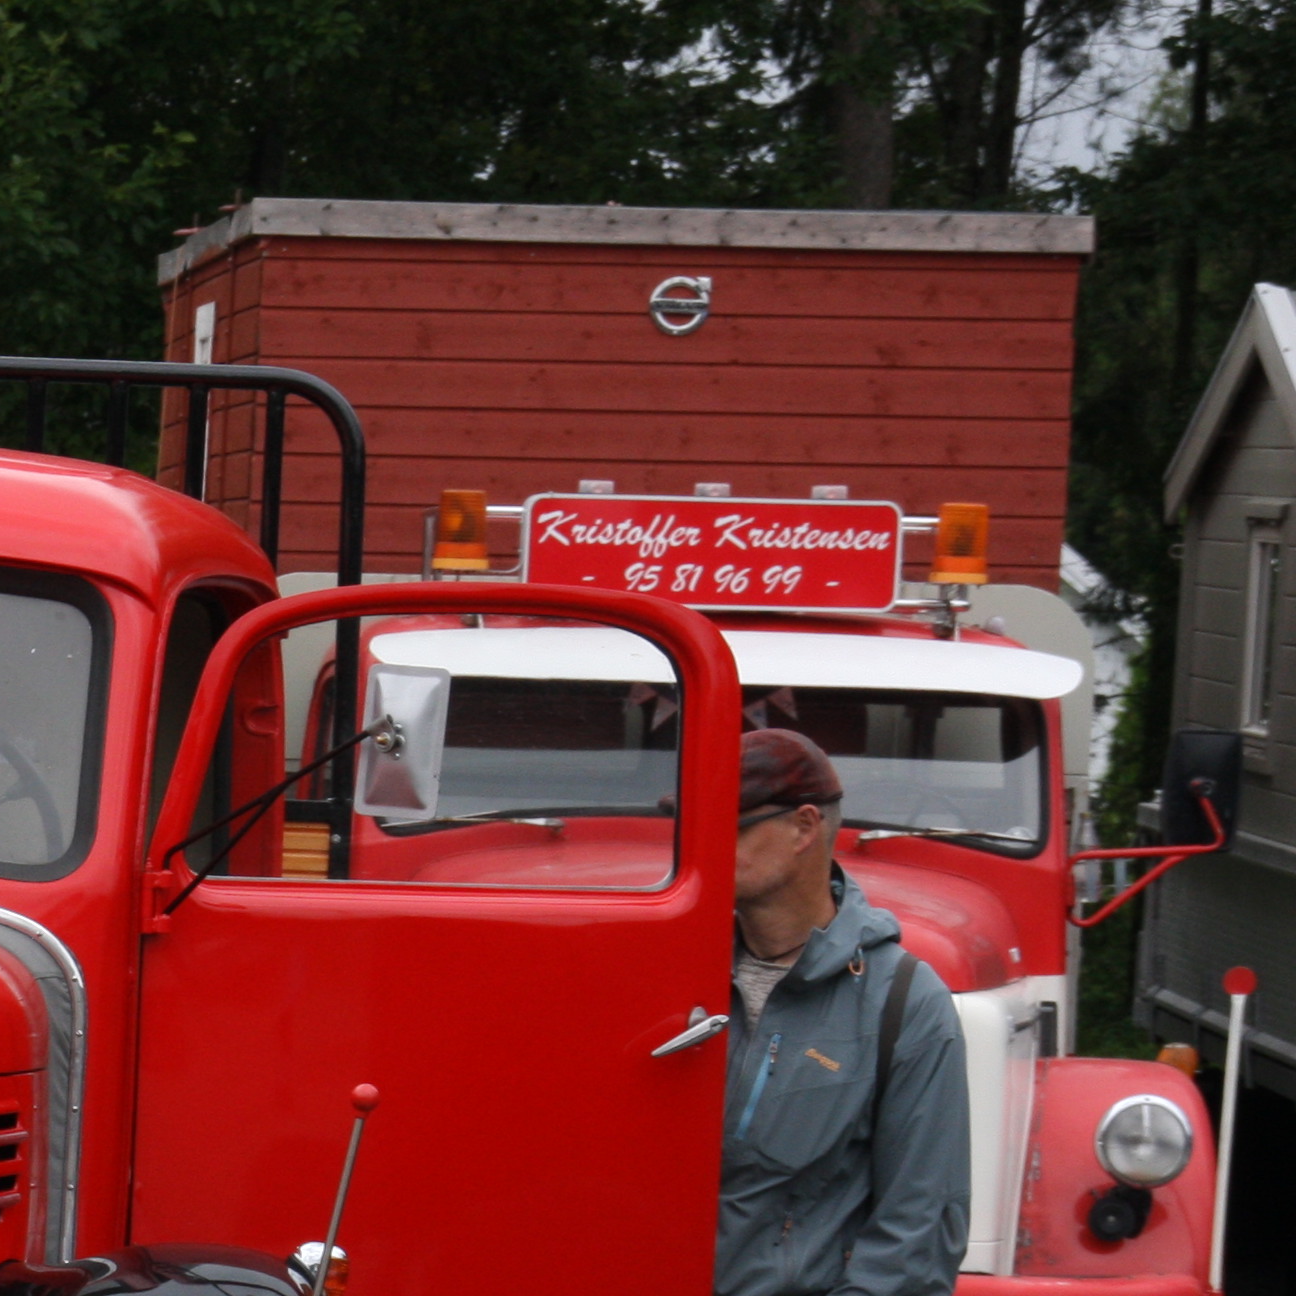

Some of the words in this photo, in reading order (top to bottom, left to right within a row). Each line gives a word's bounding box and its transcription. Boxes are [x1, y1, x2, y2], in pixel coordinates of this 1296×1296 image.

[537, 510, 701, 558] Kristoffer
[714, 514, 890, 550] Kristensen
[623, 562, 663, 592] 95
[670, 563, 704, 592] 81
[713, 564, 752, 594] 96
[761, 565, 802, 595] 99
